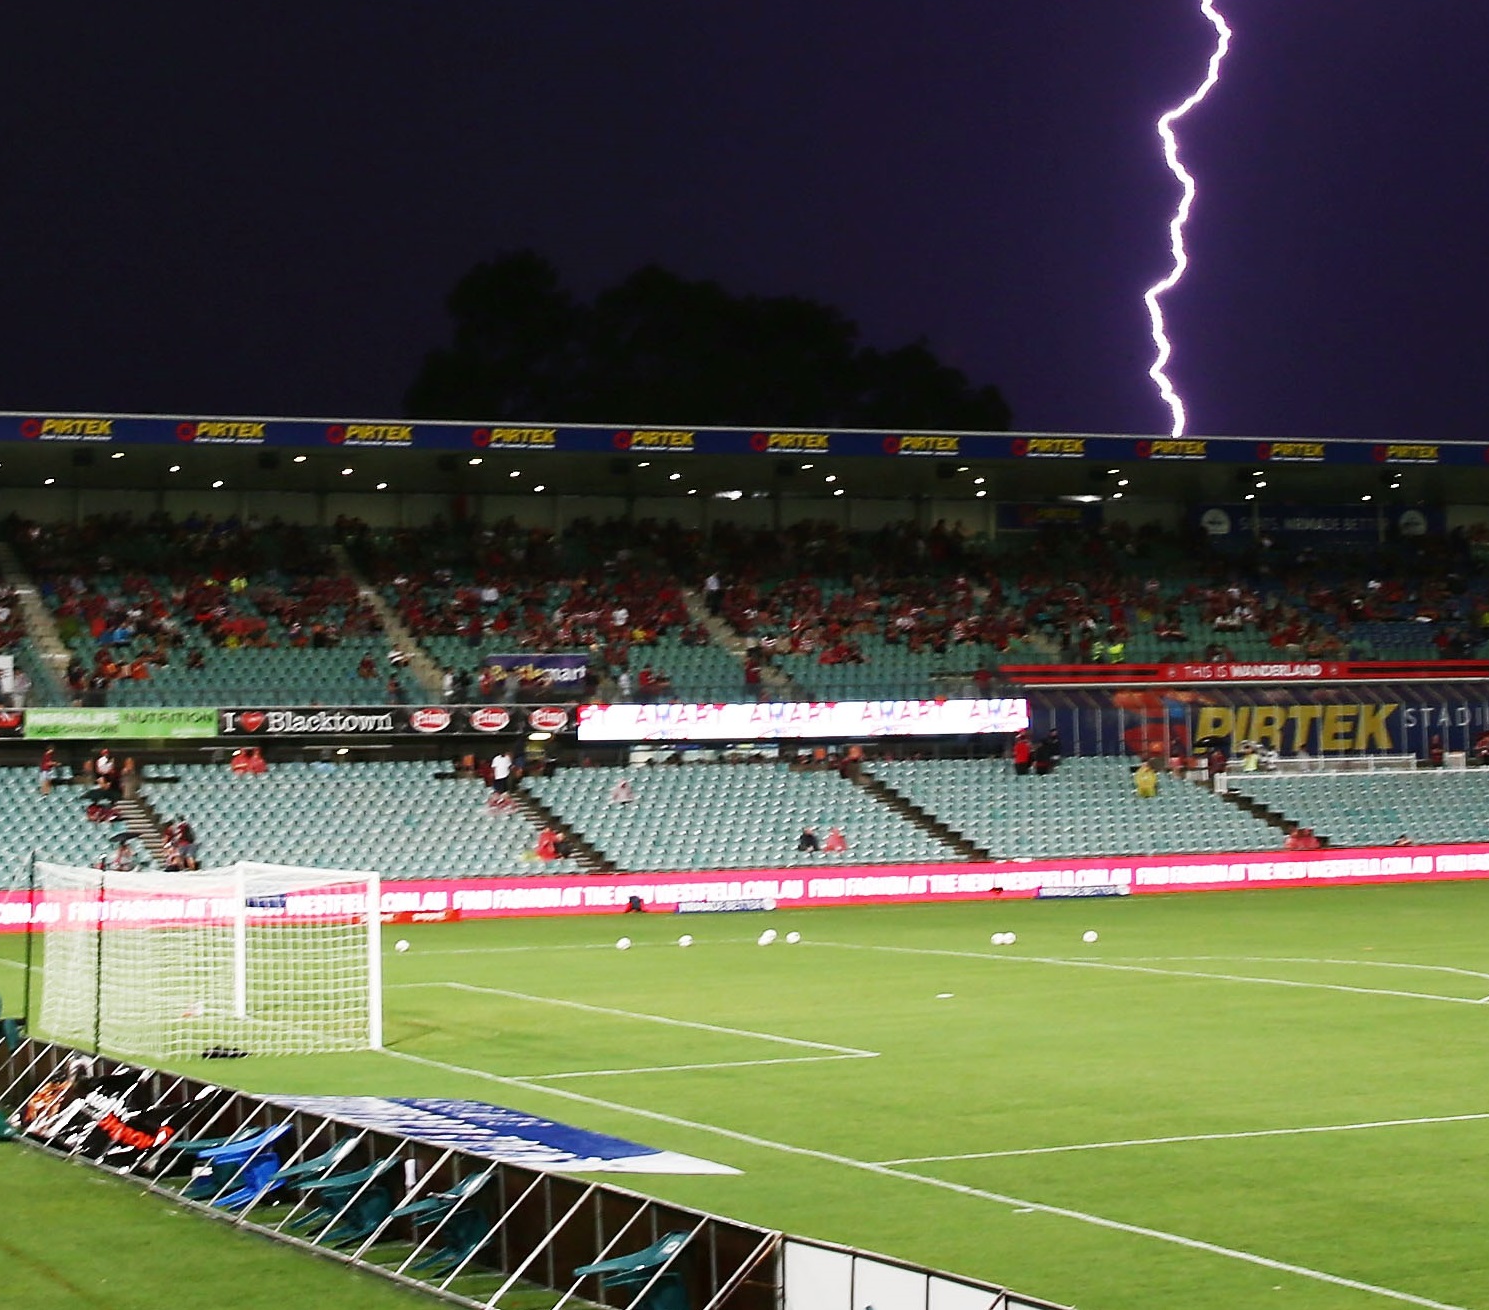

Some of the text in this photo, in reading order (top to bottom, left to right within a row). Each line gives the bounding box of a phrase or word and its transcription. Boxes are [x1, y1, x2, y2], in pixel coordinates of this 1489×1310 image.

[40, 418, 113, 435] PIRTEK
[195, 421, 265, 438] PIRTEK
[344, 424, 413, 441] PIRTEK
[489, 427, 556, 444] PIRTEK
[630, 430, 695, 447] PIRTEK
[767, 432, 829, 448] PIRTEK
[1183, 664, 1323, 679] THIS IS WANDERLAND
[223, 710, 395, 732] I Blacktown
[1194, 703, 1399, 754] PIRTEK
[1246, 862, 1274, 881] THE
[845, 875, 910, 897] FASHION
[909, 874, 930, 895] AT
[929, 873, 959, 894] THE
[492, 887, 562, 910] FASHION
[561, 886, 584, 907] AT
[583, 886, 616, 907] THE
